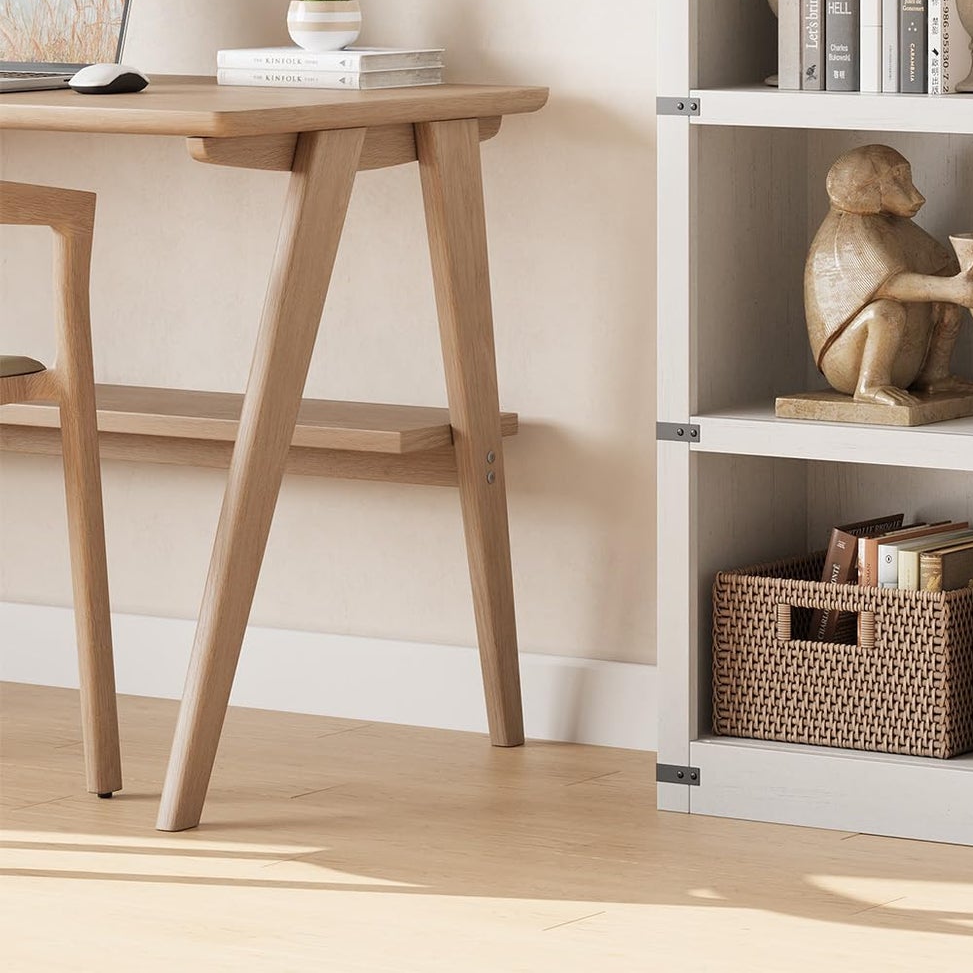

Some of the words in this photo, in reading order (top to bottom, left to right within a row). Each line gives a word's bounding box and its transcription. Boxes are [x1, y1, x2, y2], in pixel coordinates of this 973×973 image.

[828, 2, 852, 15] HELL
[830, 43, 849, 52] Charles
[265, 57, 303, 65] KINFOLK
[265, 74, 303, 83] KINFOLK
